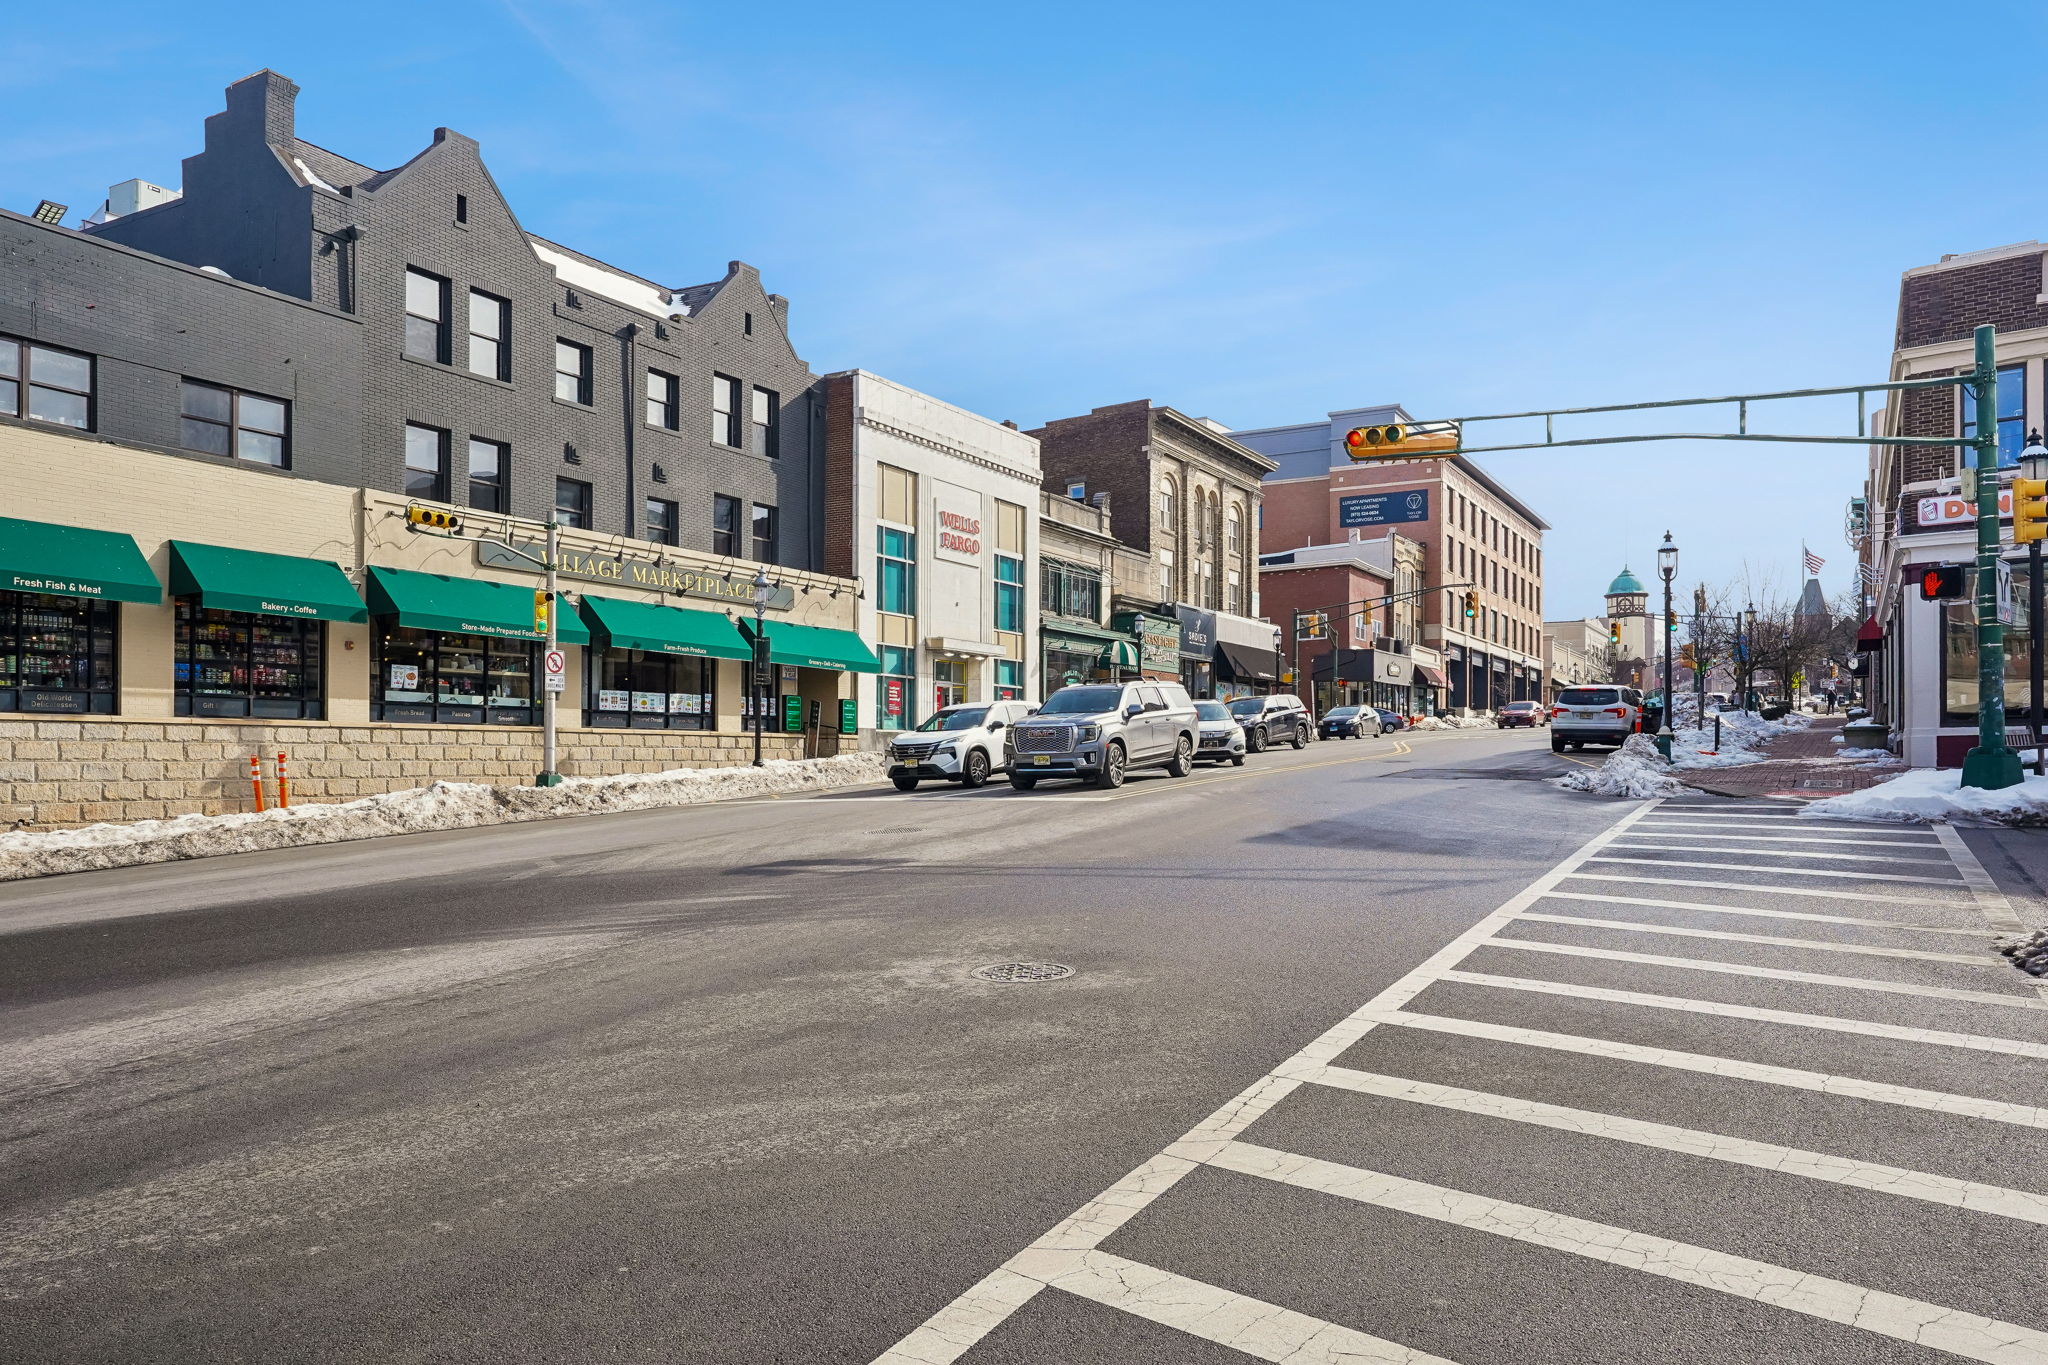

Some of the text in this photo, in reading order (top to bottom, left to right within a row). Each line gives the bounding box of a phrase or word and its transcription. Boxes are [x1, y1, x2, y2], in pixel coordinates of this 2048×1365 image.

[941, 511, 980, 534] WELLS
[941, 532, 980, 554] FARGO
[13, 576, 102, 594] Fresh Fish & Meat
[633, 565, 755, 600] MARKETPLACE
[261, 601, 318, 615] Bakery Coffee
[461, 622, 496, 634] Store-Made
[496, 626, 521, 637] Prepared
[1188, 631, 1208, 643] SADIE'S
[36, 693, 49, 701] Old
